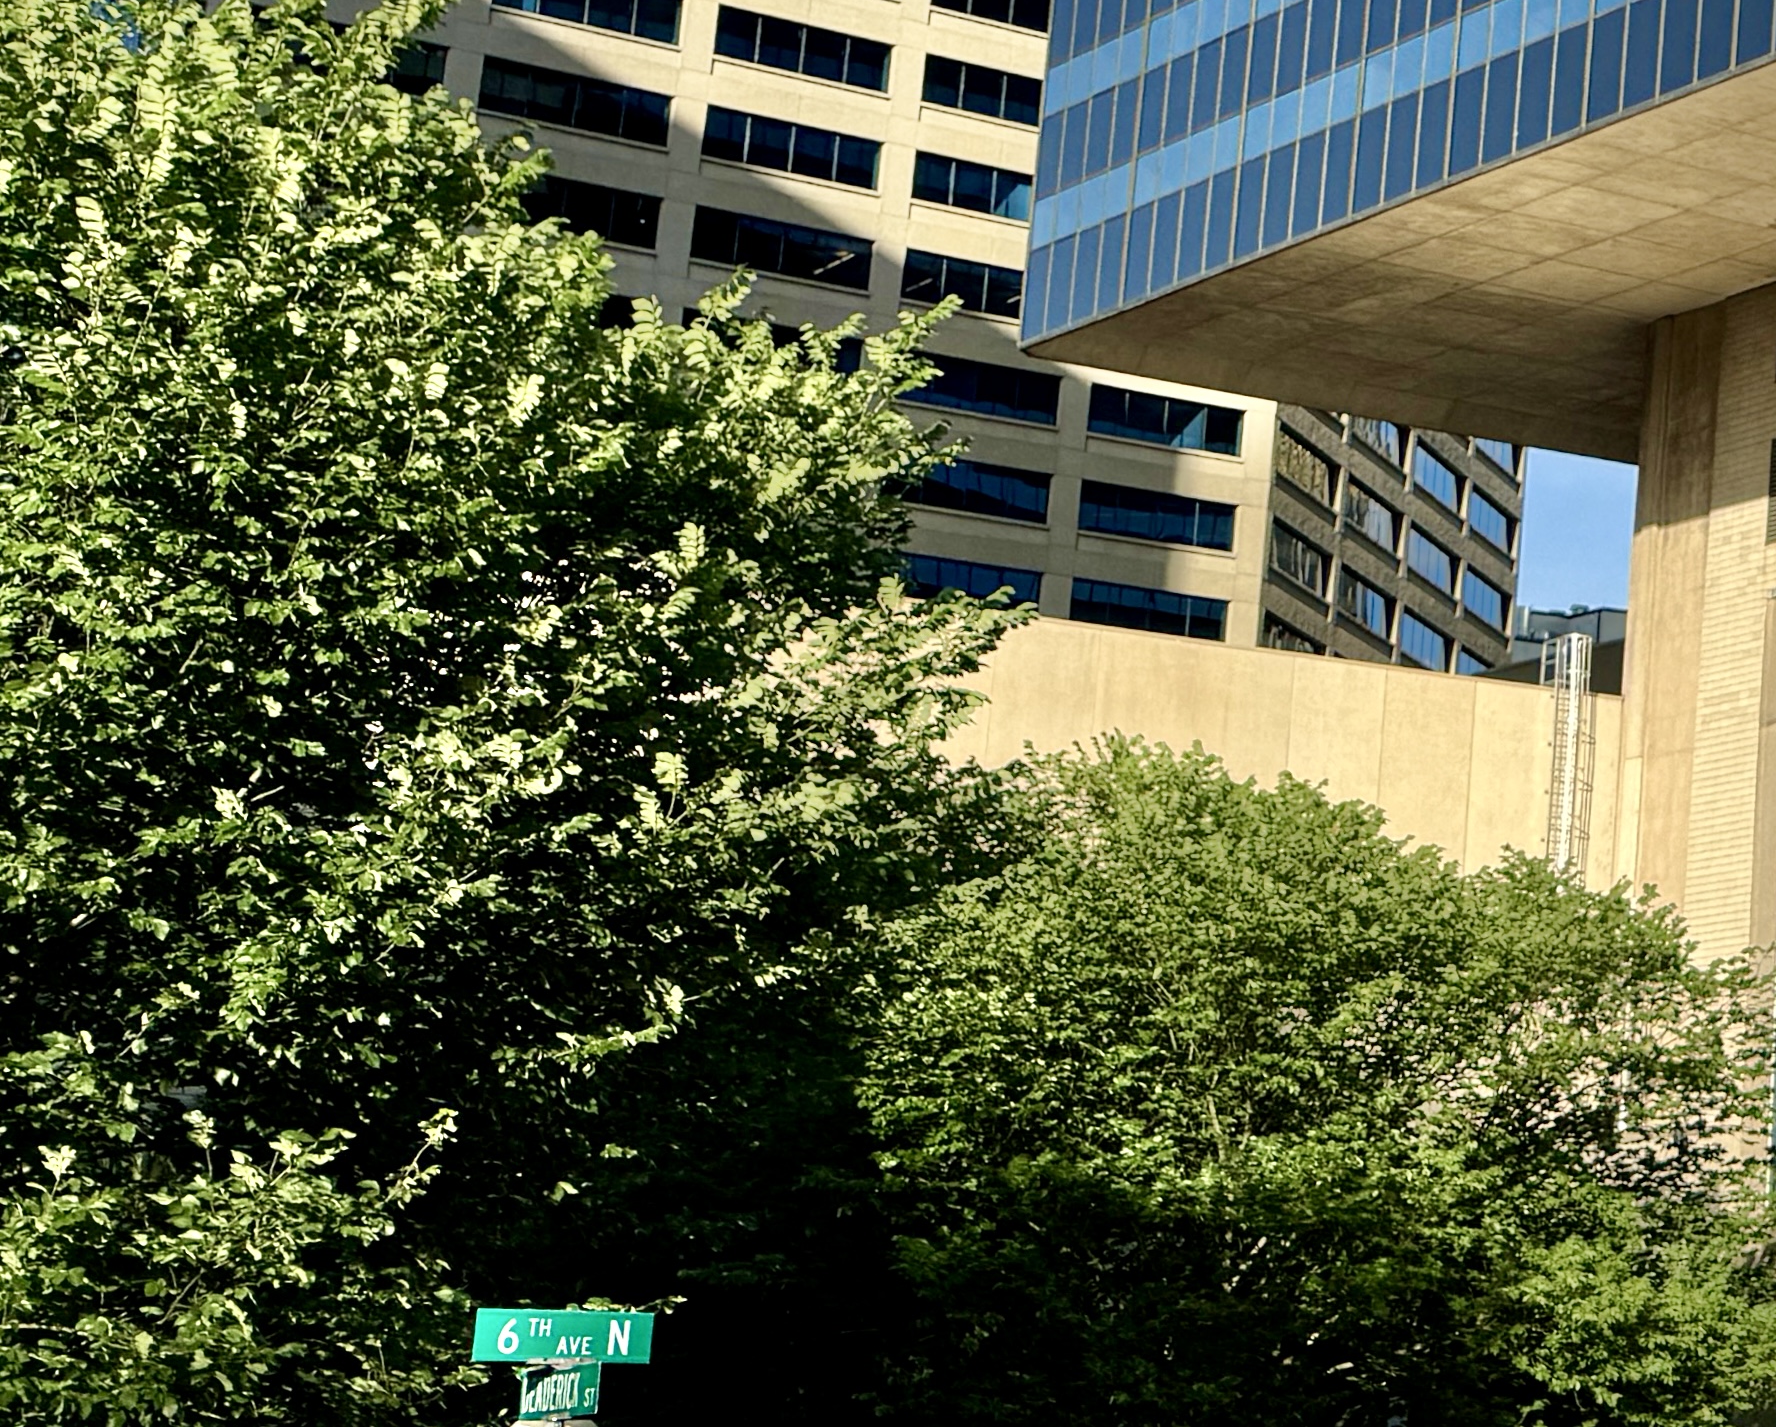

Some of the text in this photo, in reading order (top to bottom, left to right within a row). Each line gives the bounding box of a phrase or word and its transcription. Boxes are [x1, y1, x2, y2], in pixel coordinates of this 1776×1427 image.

[556, 1336, 593, 1356] AVE
[607, 1319, 632, 1356] N
[583, 1387, 596, 1408] ST
